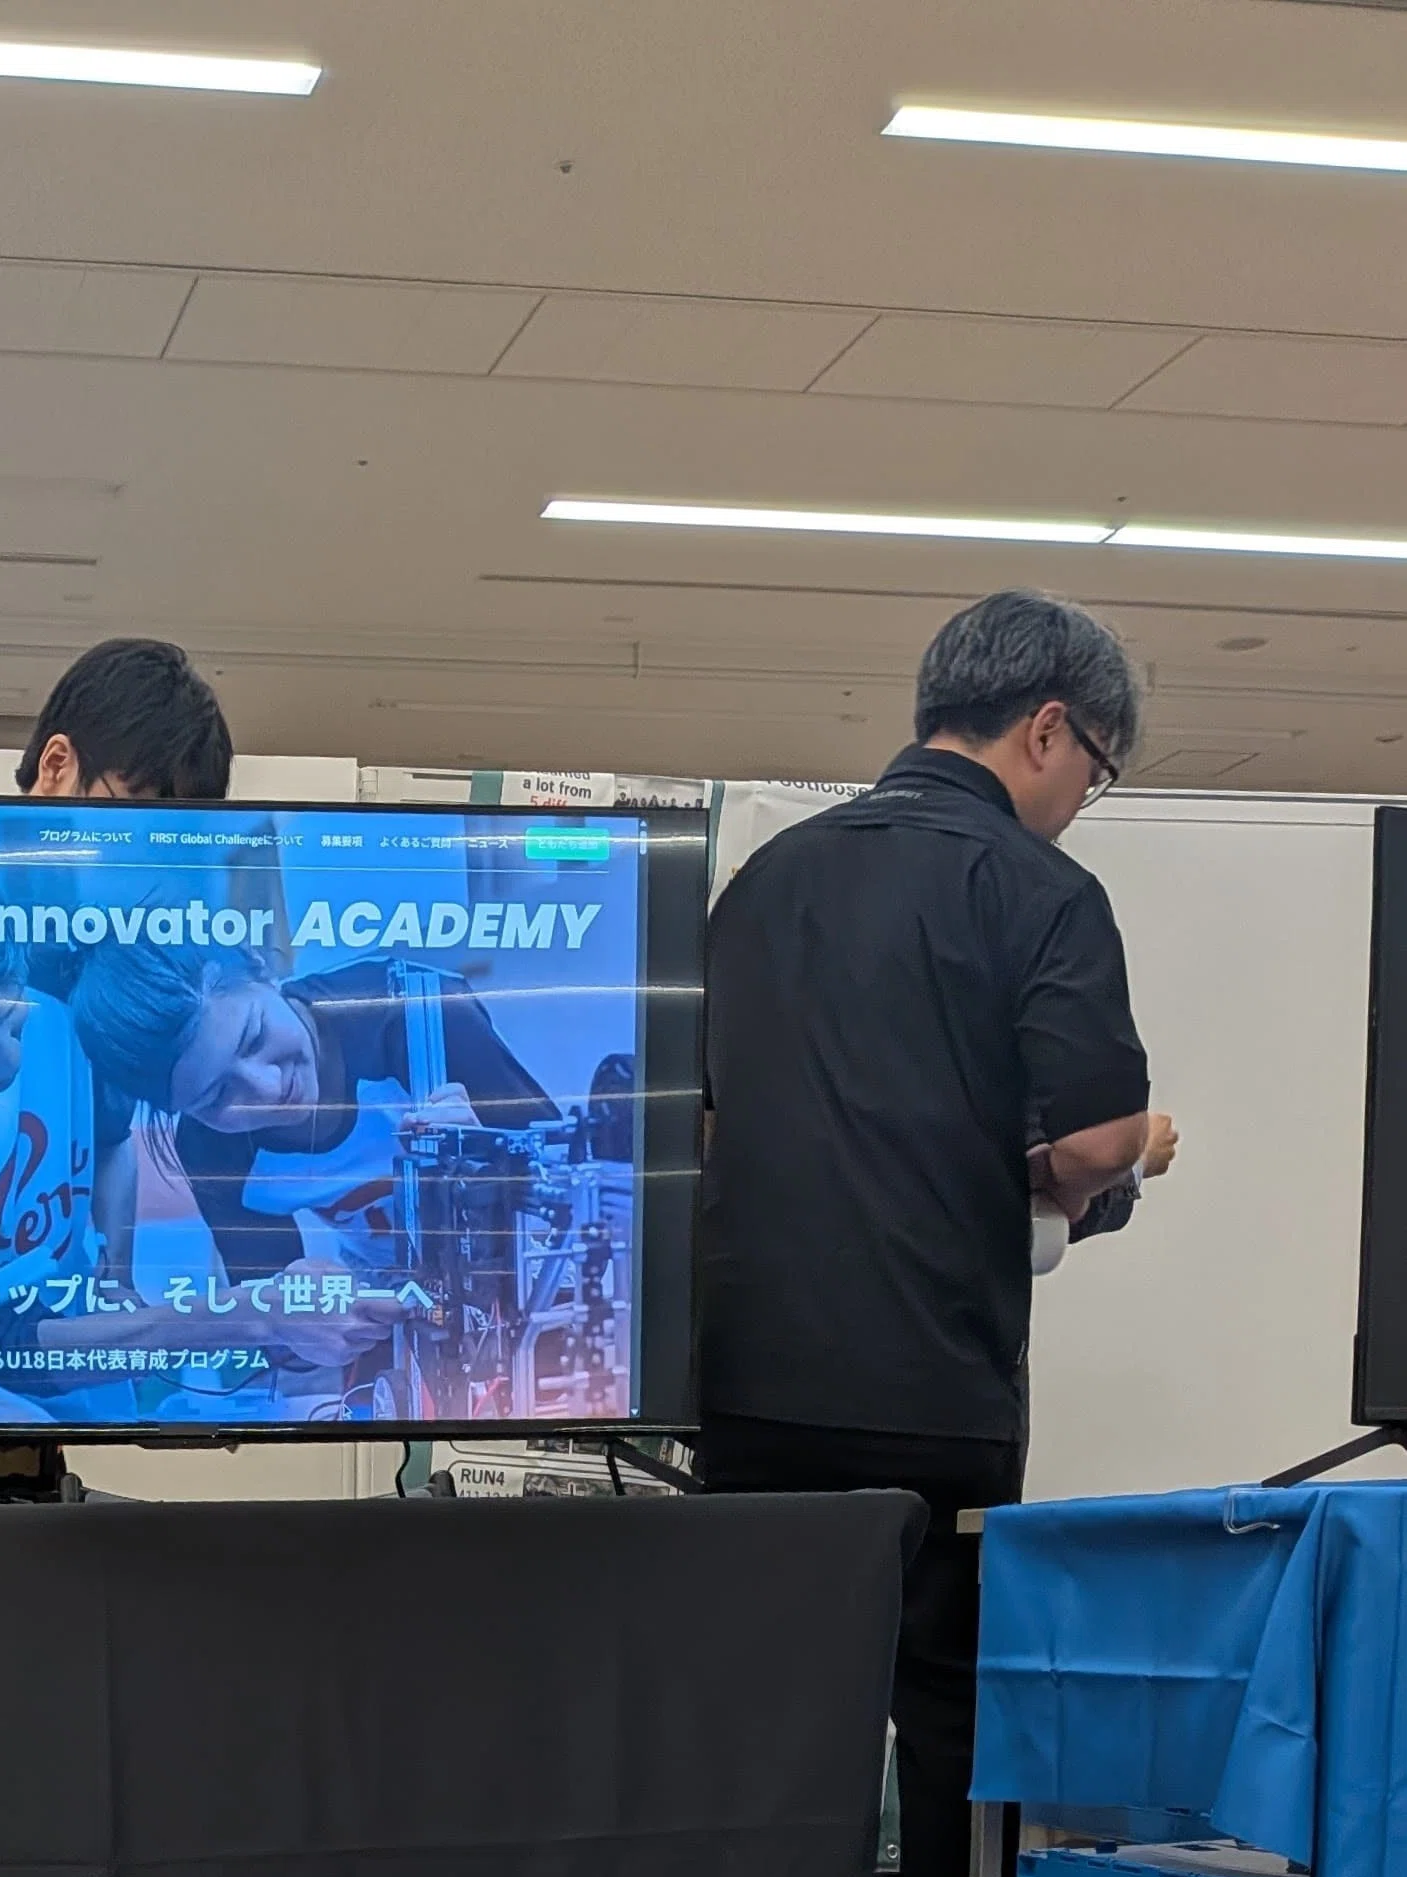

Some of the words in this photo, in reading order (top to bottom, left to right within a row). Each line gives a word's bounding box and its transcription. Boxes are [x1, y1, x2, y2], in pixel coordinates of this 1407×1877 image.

[522, 778, 532, 790] a
[535, 777, 555, 793] lot
[559, 781, 592, 799] from
[39, 829, 133, 844] プログラムについて
[149, 833, 178, 844] FIRST
[180, 833, 212, 846] Global
[291, 900, 602, 950] ACADEMY
[460, 1467, 505, 1486] RUN4
